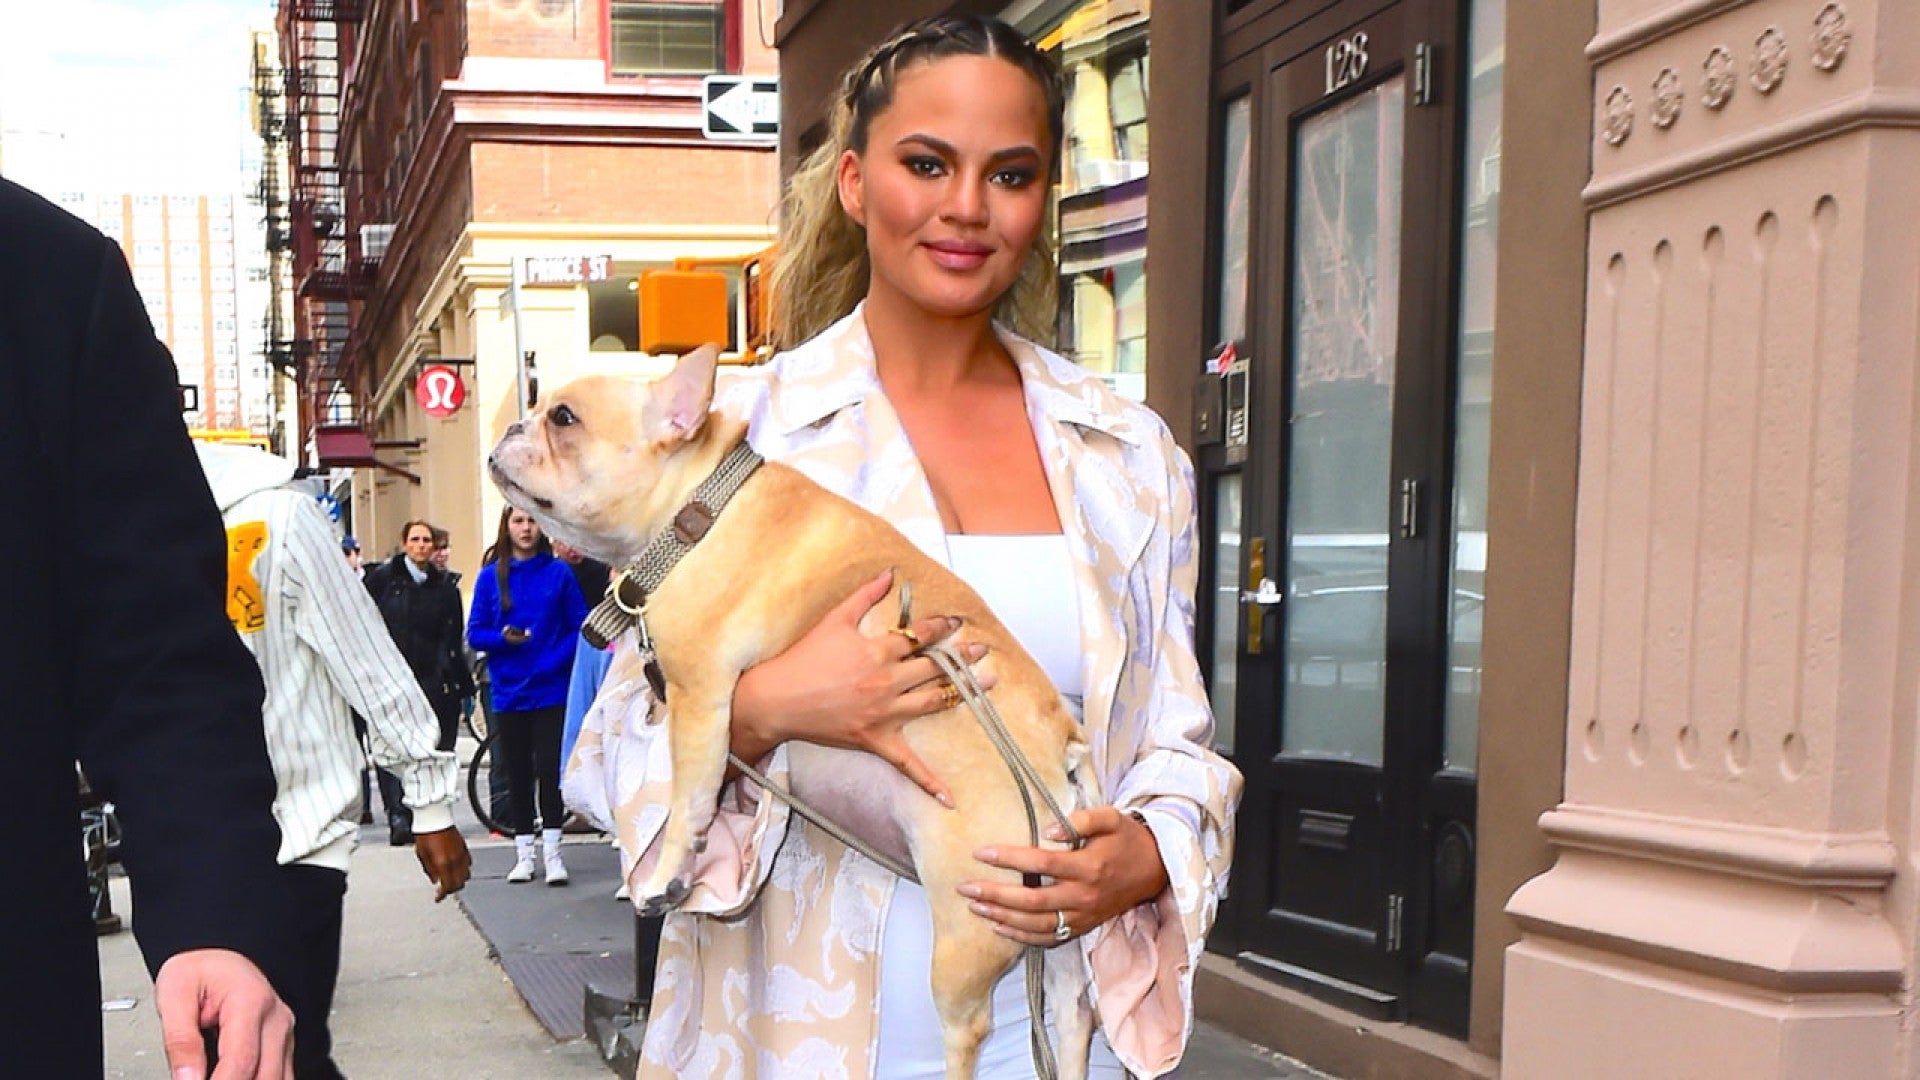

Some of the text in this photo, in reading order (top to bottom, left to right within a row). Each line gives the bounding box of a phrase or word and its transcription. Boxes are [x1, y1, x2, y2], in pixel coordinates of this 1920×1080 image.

[1325, 32, 1368, 95] 128
[527, 257, 608, 281] PRINCE ST
